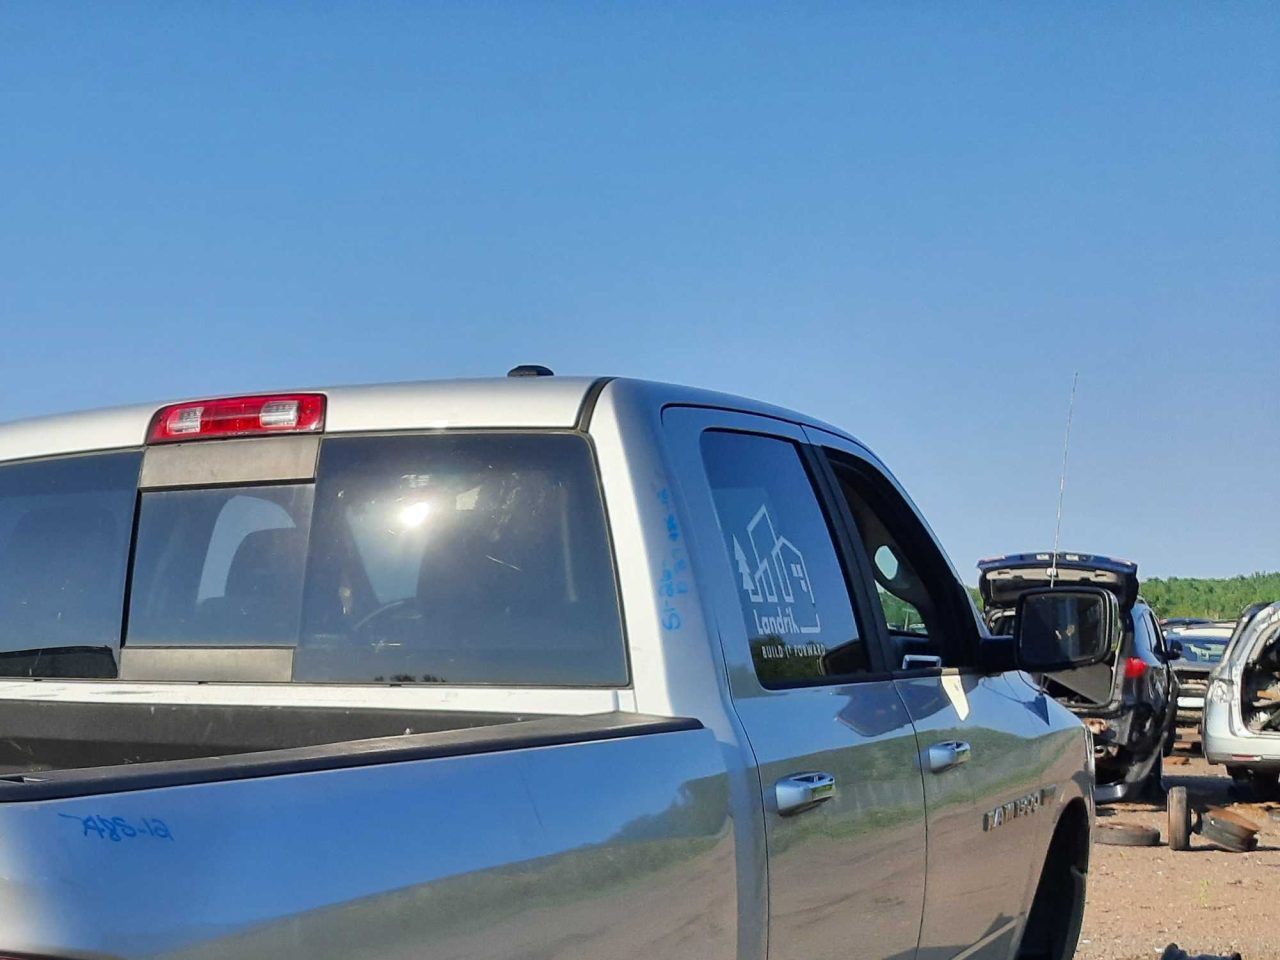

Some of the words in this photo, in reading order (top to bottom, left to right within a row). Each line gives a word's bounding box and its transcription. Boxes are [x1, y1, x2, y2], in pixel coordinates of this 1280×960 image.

[753, 606, 800, 635] Landrik
[761, 645, 784, 659] BUILD
[794, 643, 826, 657] FORWARD
